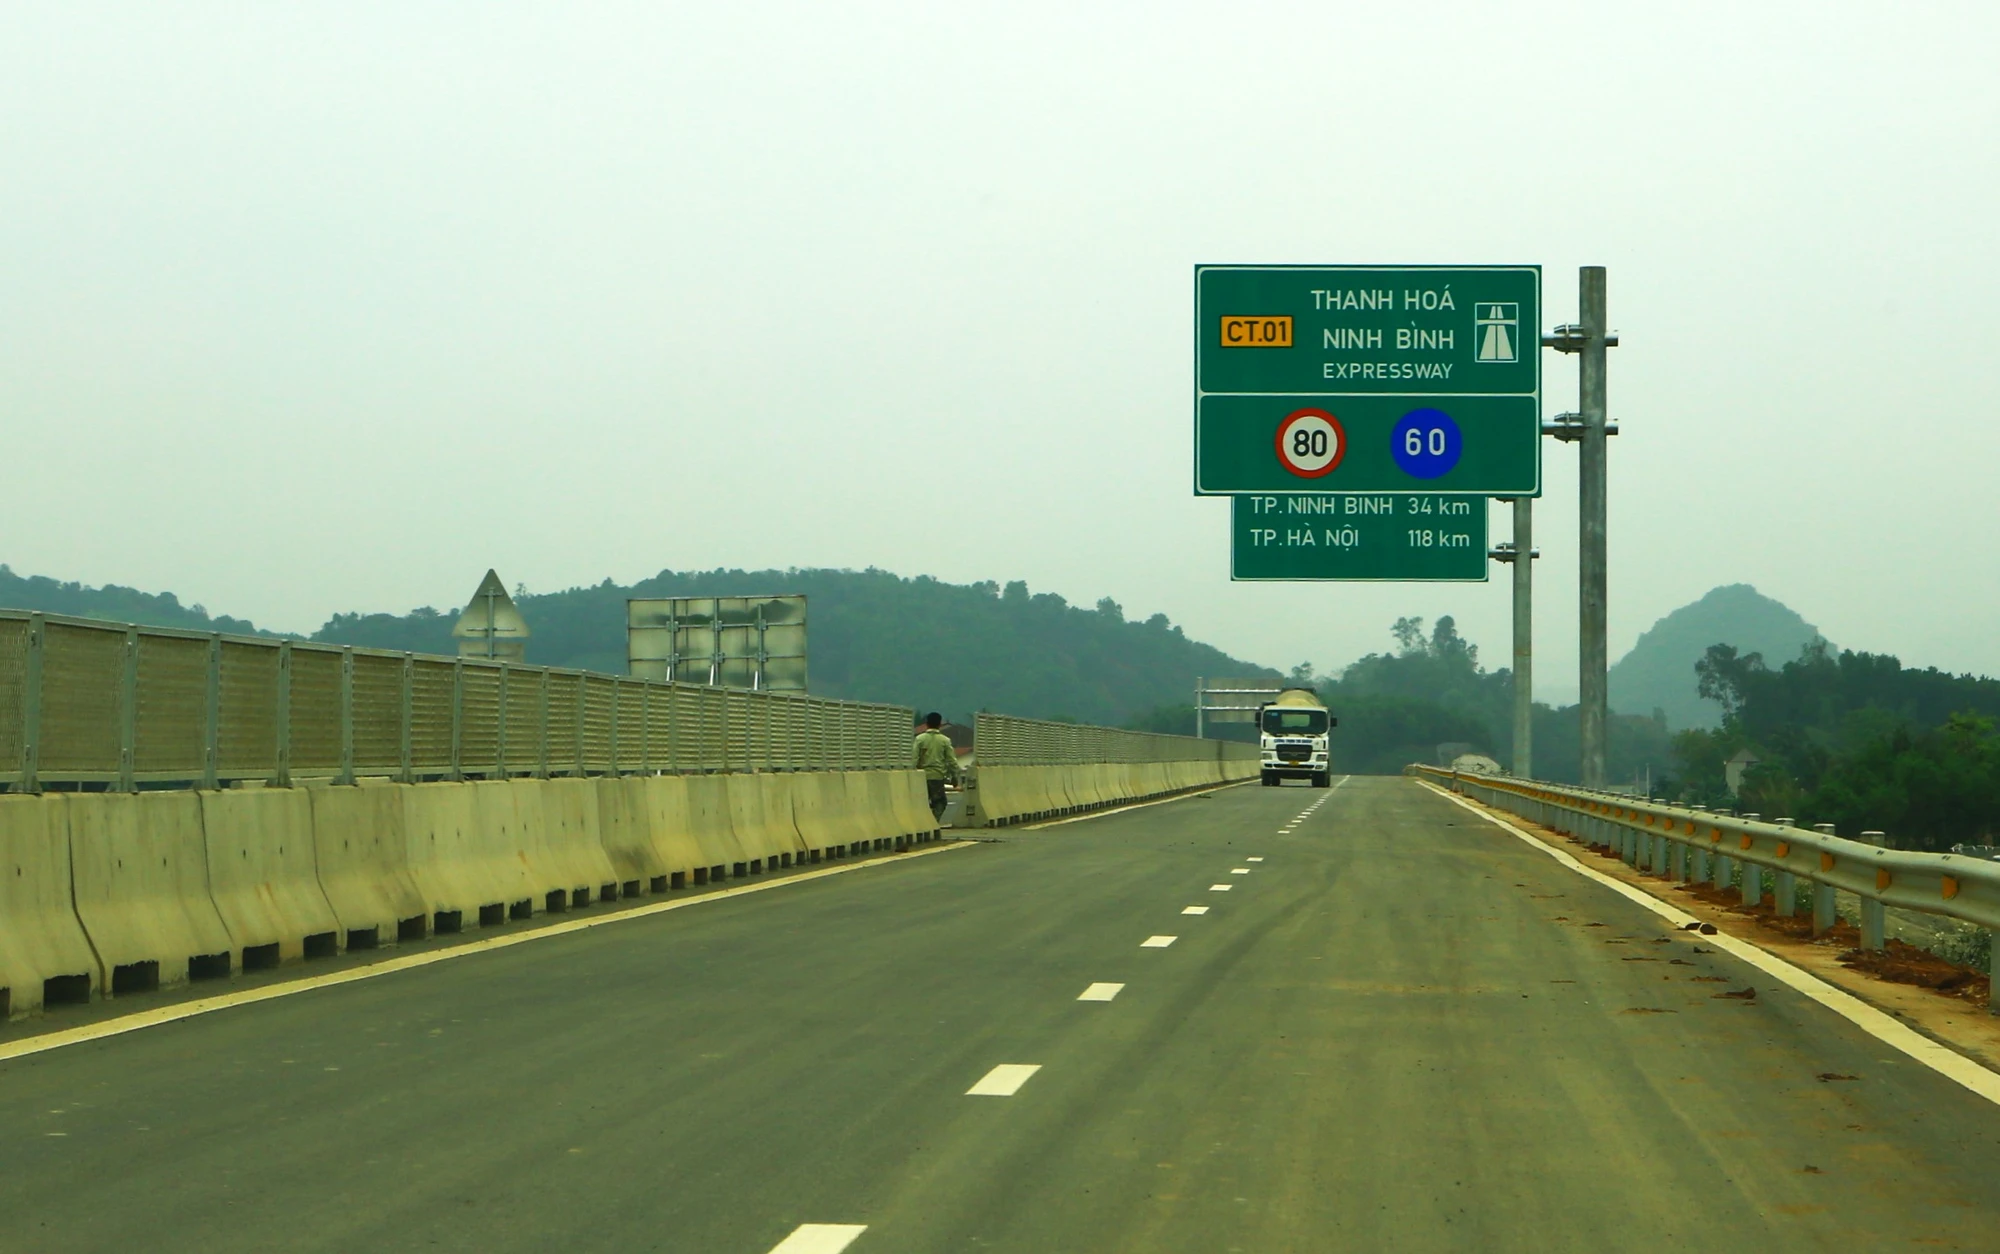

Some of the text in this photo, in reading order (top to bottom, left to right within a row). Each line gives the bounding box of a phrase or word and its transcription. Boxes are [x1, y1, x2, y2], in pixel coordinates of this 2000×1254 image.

[1311, 284, 1456, 310] THANH HOÁ
[1227, 320, 1287, 342] CT.01
[1323, 321, 1454, 349] NINH BÌNH
[1323, 363, 1453, 378] EXPRESSWAY
[1293, 429, 1328, 457] 80
[1405, 427, 1446, 456] 60
[1408, 497, 1433, 515] 34
[1439, 497, 1470, 515] km
[1325, 523, 1359, 551] NỘI
[1407, 529, 1433, 546] 118
[1439, 529, 1470, 546] km
